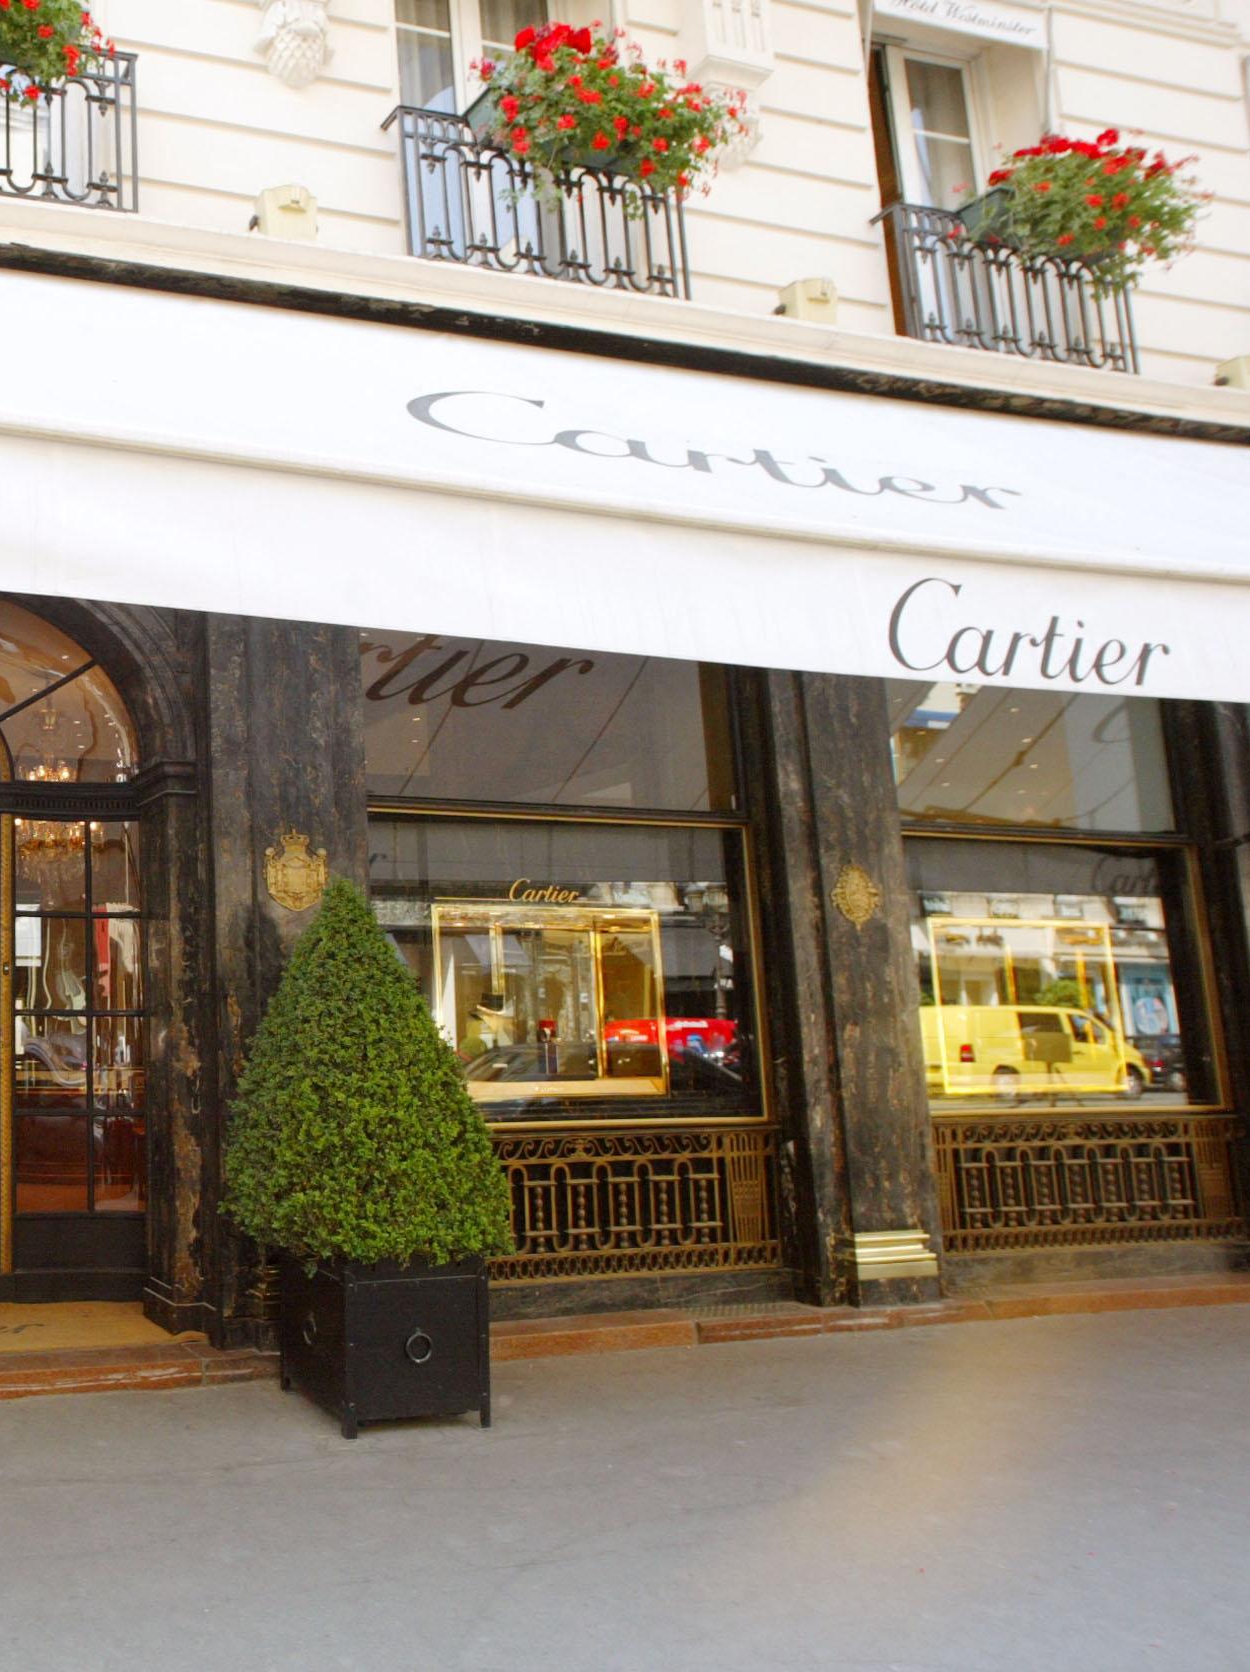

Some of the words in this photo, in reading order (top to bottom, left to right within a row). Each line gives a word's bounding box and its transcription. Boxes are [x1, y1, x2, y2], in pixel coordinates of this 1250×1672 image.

[944, 2, 1037, 35] Westminster
[406, 391, 1021, 509] Cartier
[889, 578, 1170, 686] Cartier
[359, 634, 594, 709] rtier
[510, 878, 579, 902] Cartier
